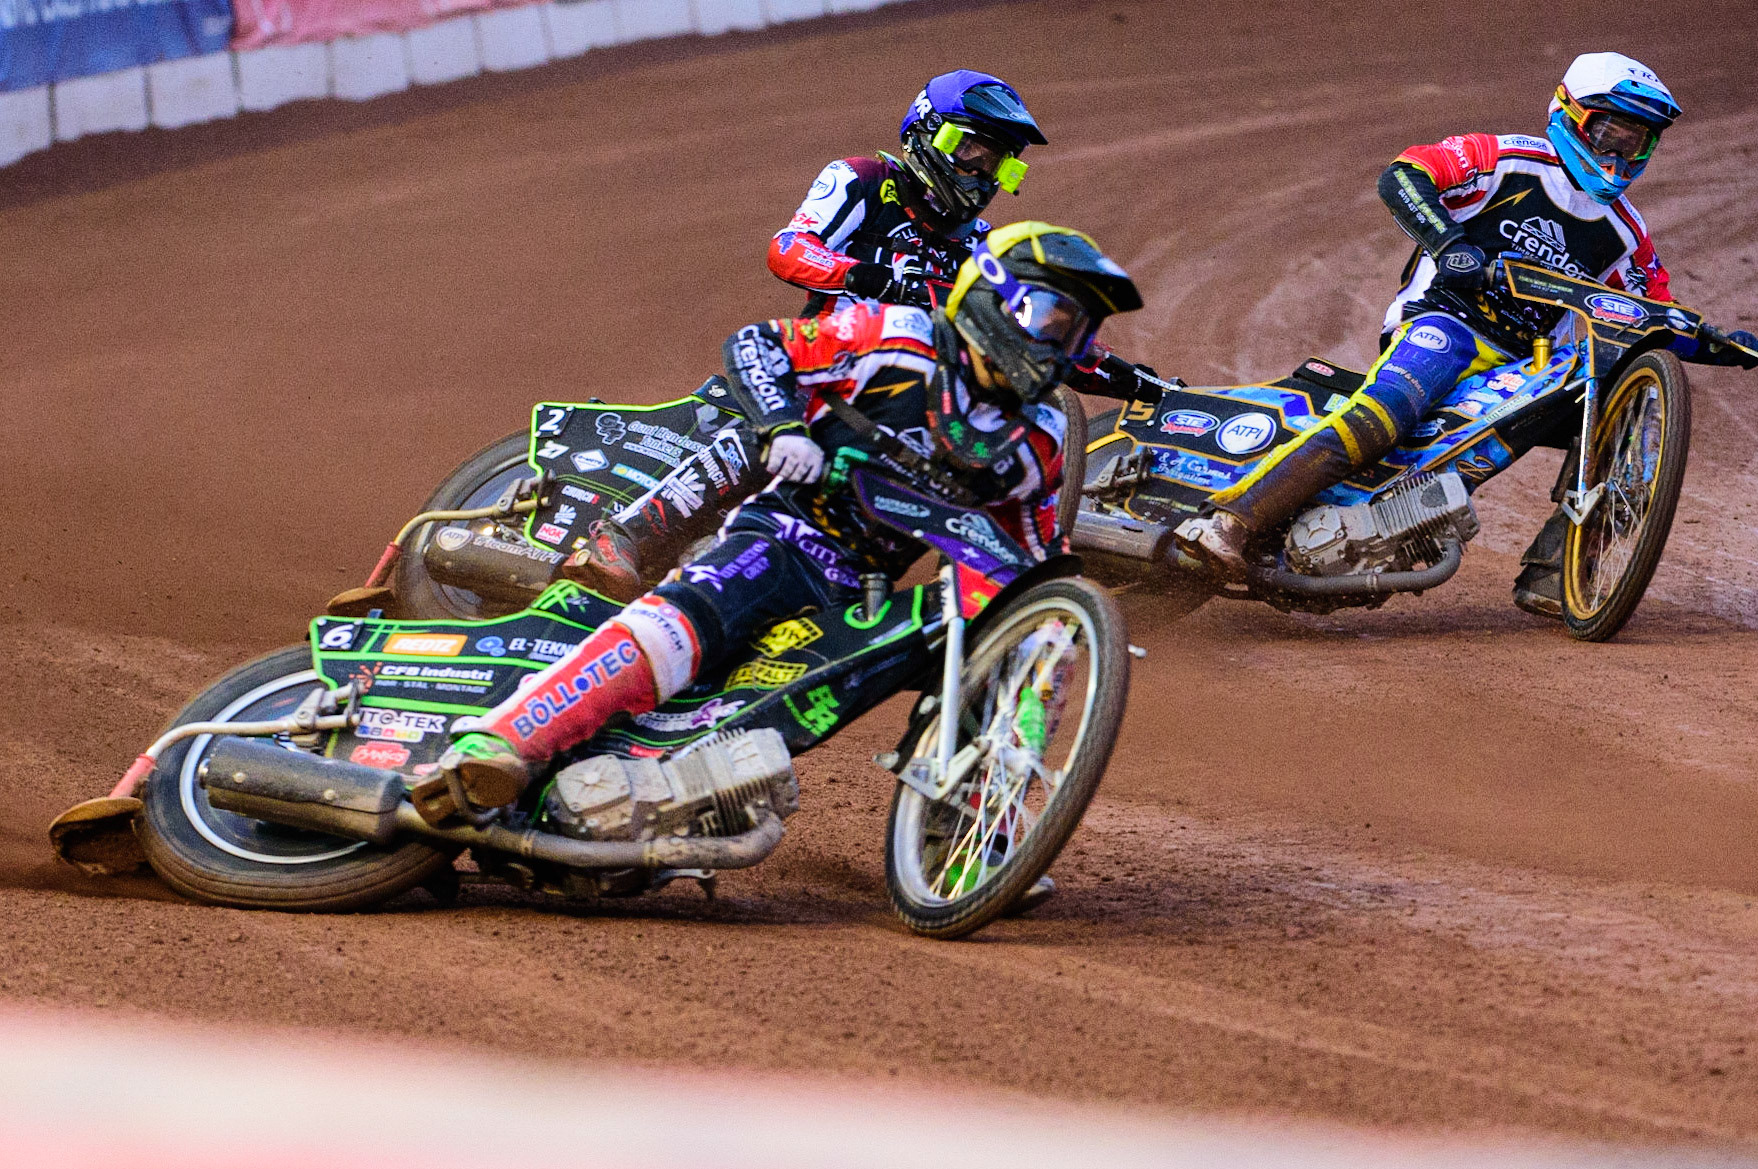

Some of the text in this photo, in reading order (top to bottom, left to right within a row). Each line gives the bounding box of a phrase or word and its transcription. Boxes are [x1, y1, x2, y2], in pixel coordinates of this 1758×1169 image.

[1413, 331, 1444, 345] ATPI
[738, 324, 786, 411] Crendon
[539, 408, 566, 431] 2
[1226, 424, 1264, 440] ATPI
[540, 526, 565, 539] NGK
[321, 624, 354, 648] 6
